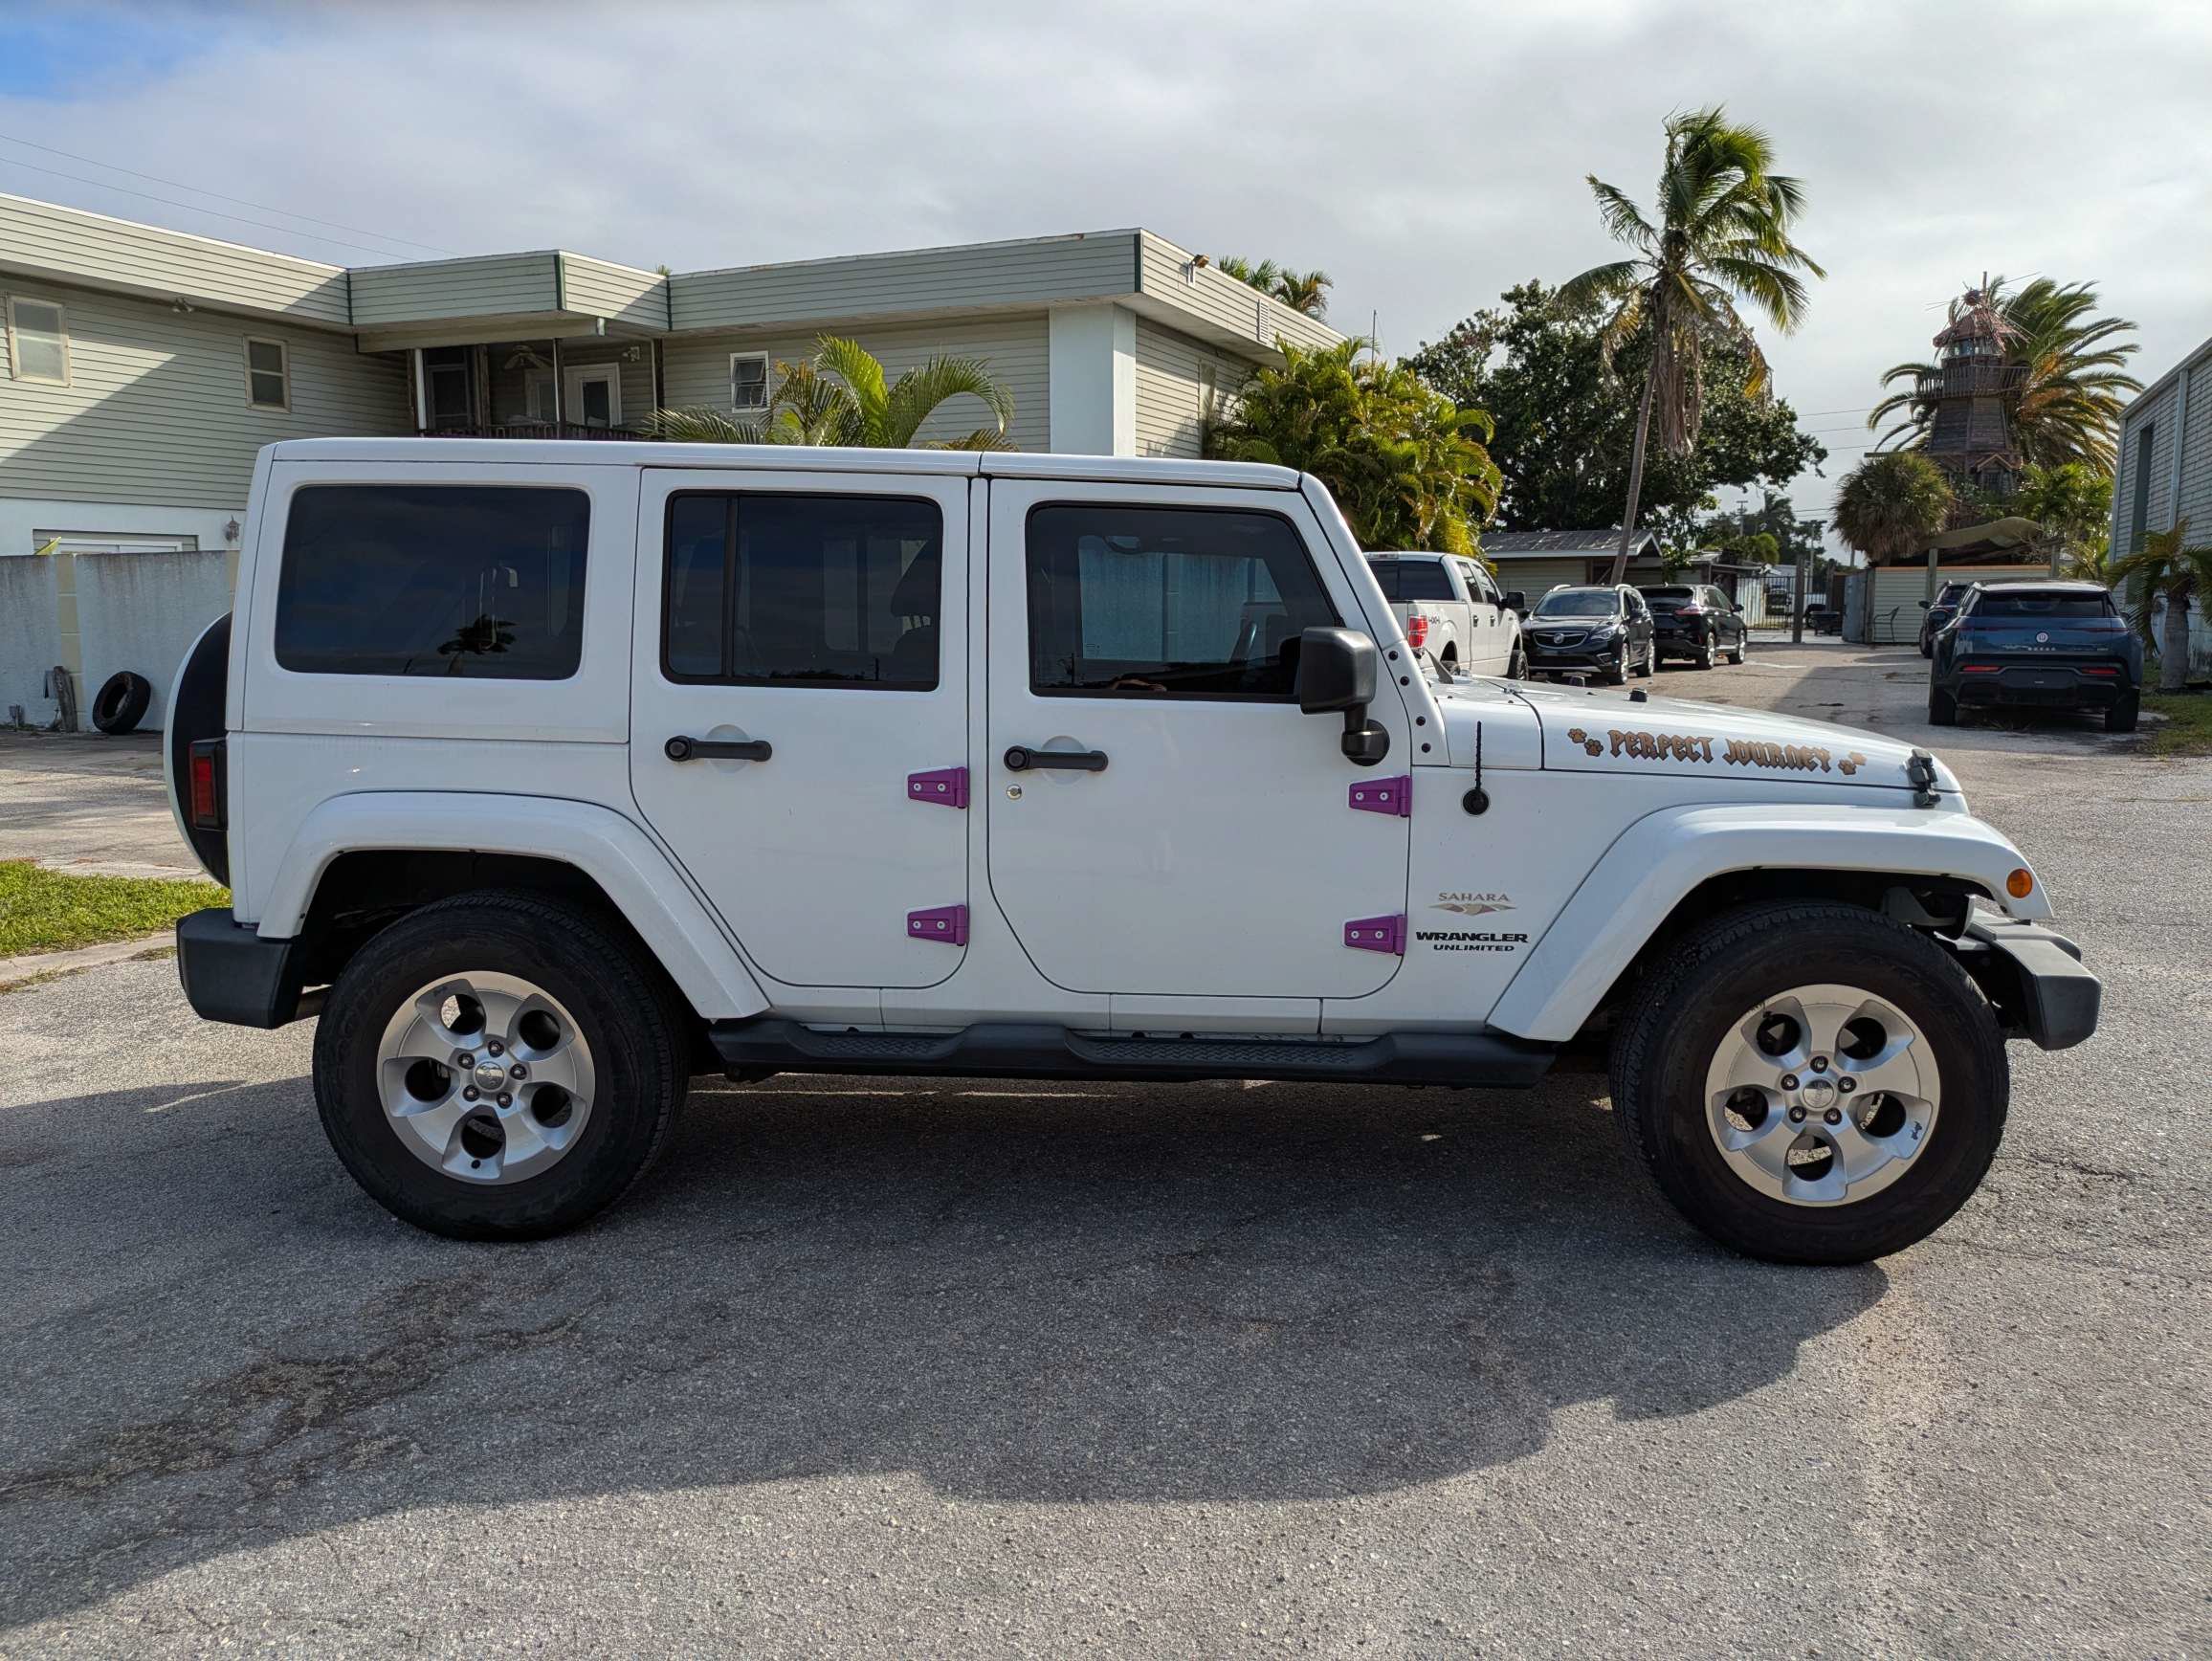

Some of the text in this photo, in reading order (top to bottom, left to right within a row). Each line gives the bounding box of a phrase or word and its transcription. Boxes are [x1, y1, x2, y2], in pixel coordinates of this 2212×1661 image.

[1607, 729, 1831, 773] PERFECT JOURNEY
[1438, 892, 1510, 901] SAHARA
[1416, 931, 1530, 943] WRANGLER
[1433, 943, 1515, 952] UNLIMITED
